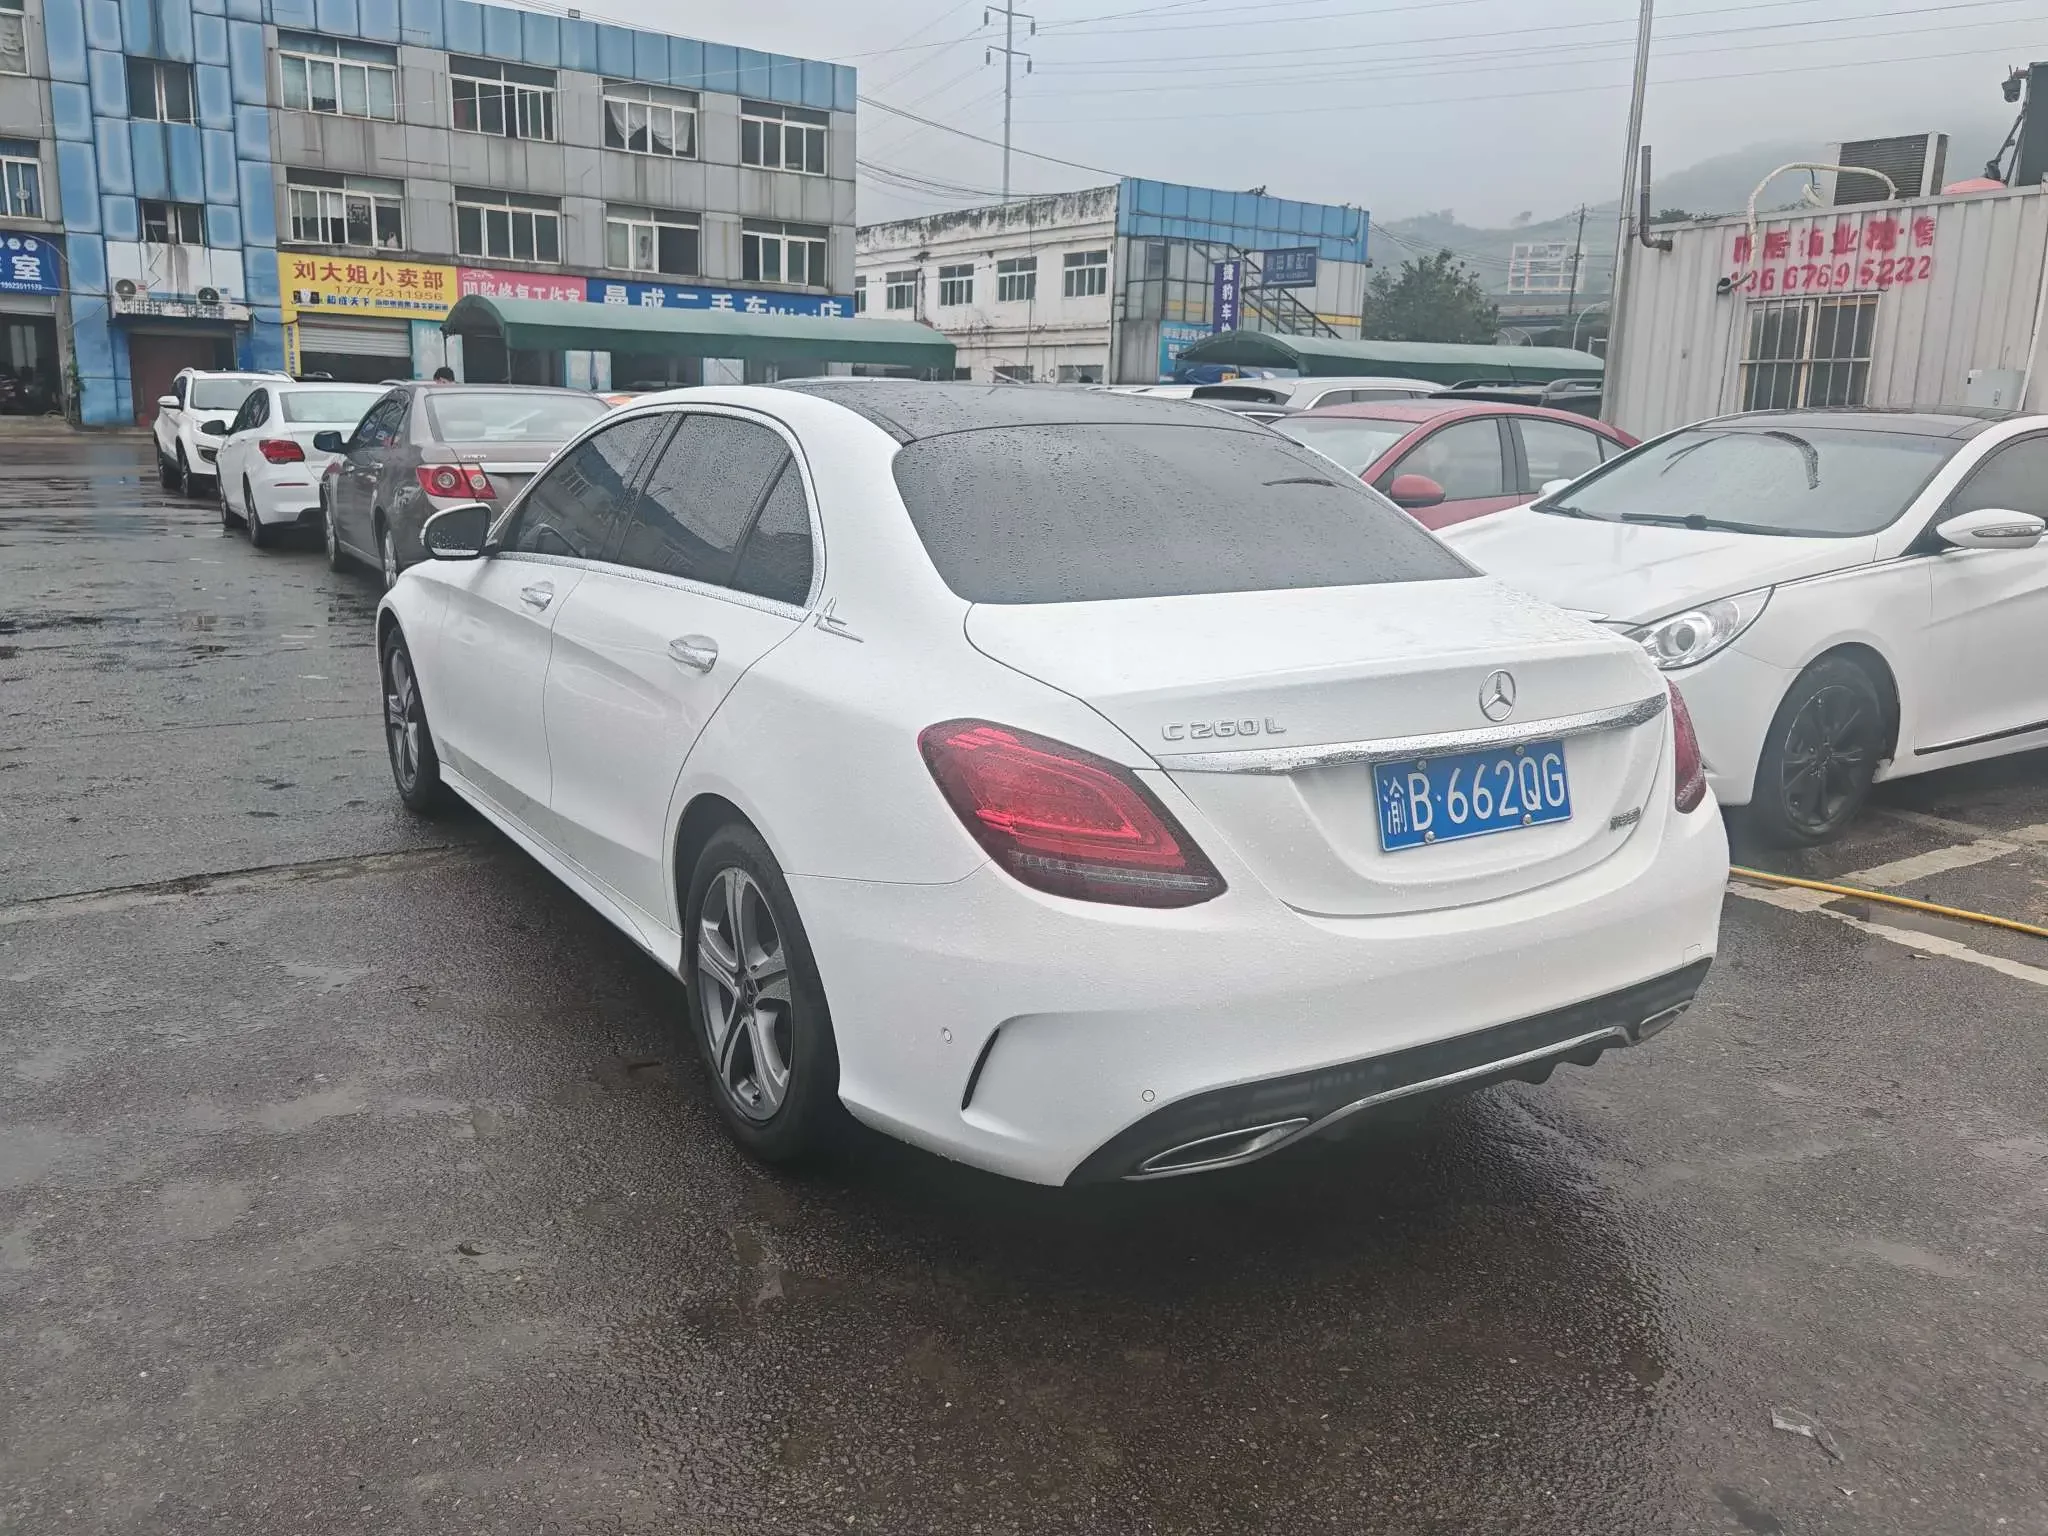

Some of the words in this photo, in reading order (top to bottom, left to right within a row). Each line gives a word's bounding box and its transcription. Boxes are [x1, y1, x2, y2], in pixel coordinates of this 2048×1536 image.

[0, 254, 41, 280] 室
[293, 260, 443, 290] 刘大姐小卖部
